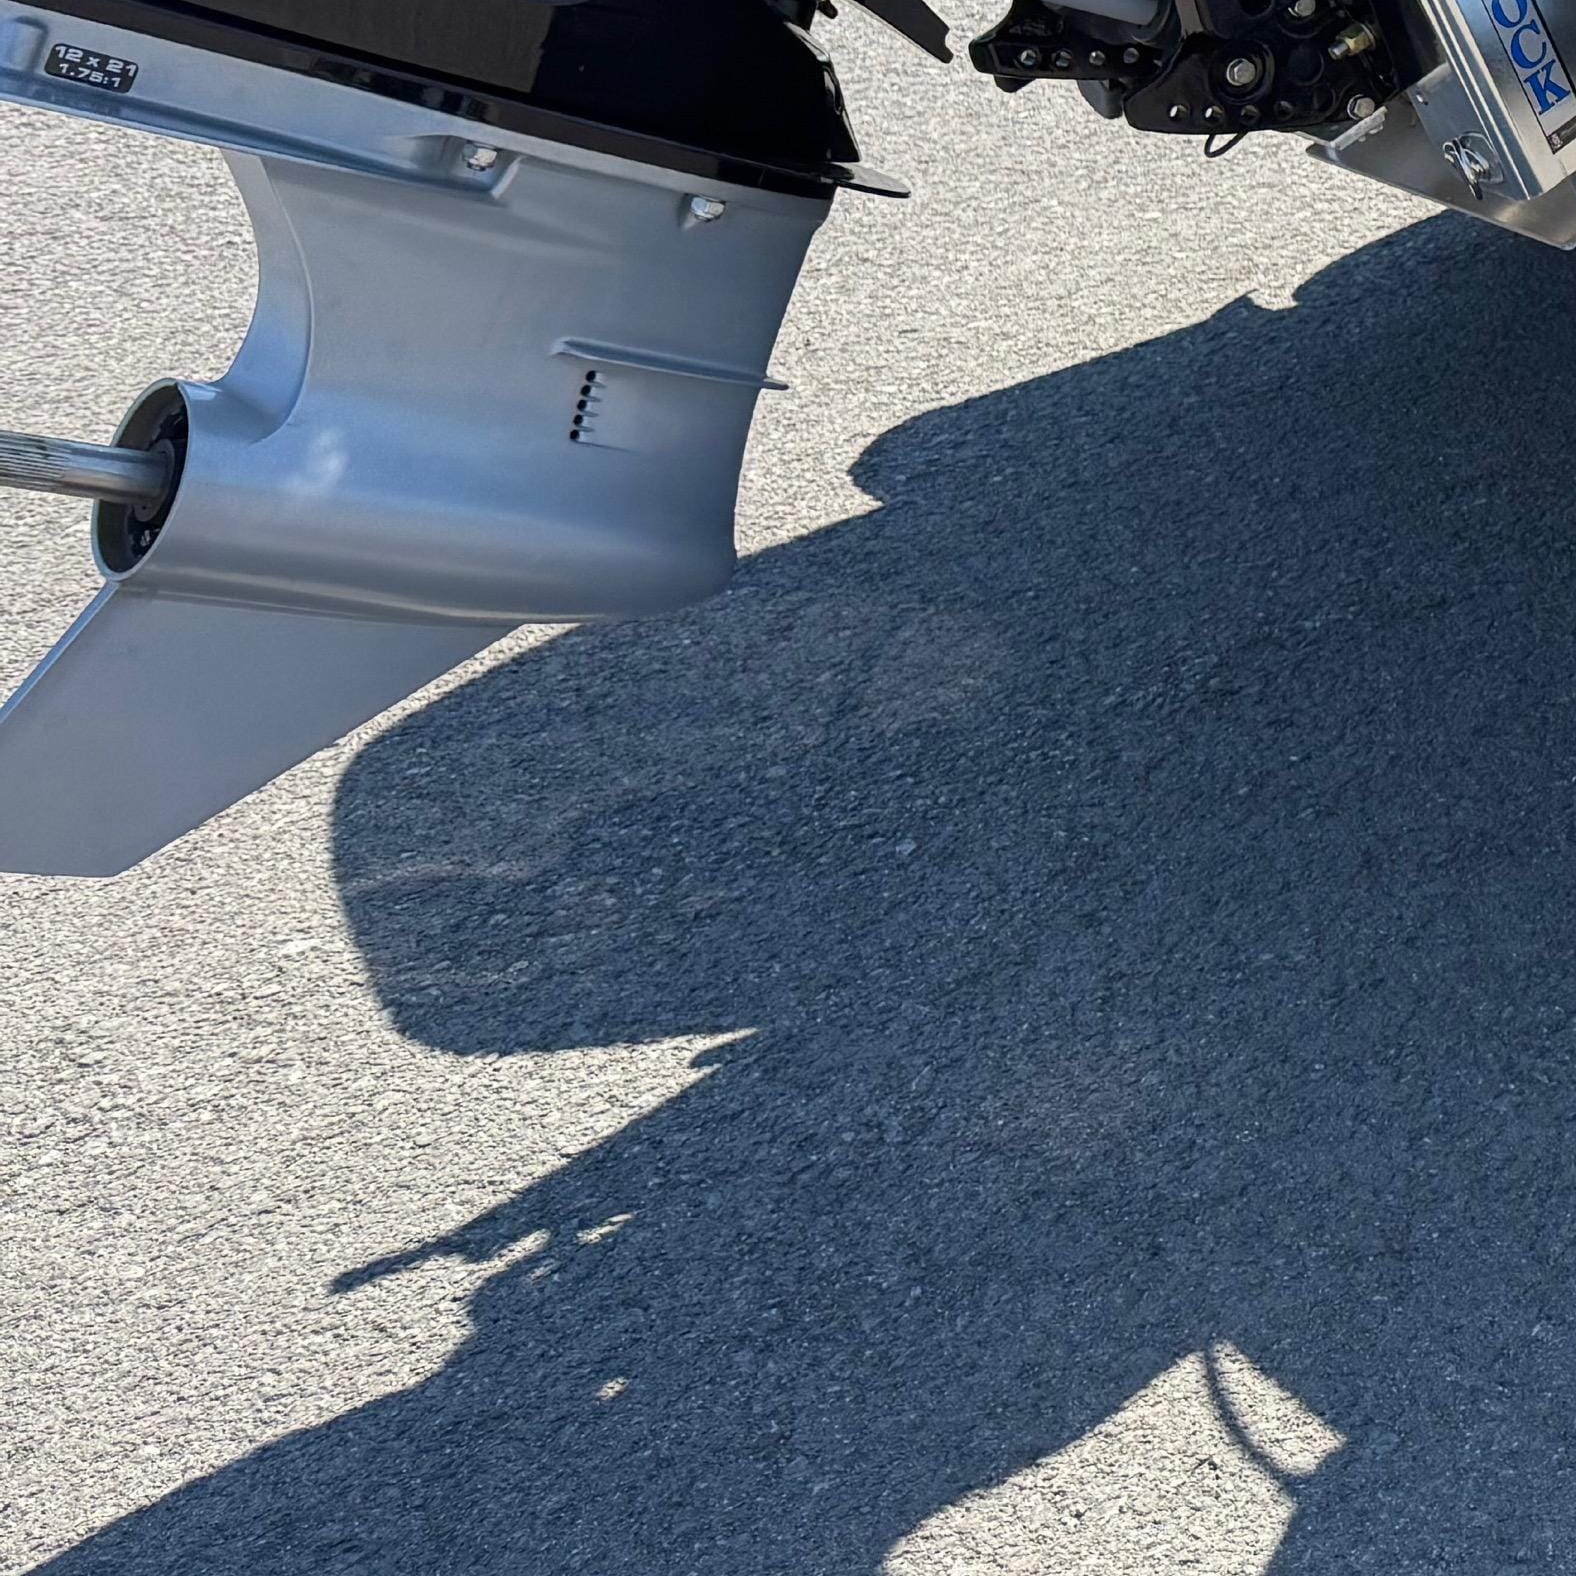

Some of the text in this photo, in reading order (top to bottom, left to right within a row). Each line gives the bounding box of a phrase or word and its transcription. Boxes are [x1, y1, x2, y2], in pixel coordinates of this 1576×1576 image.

[55, 45, 137, 77] 12 x 21
[59, 63, 121, 88] 1.75:1
